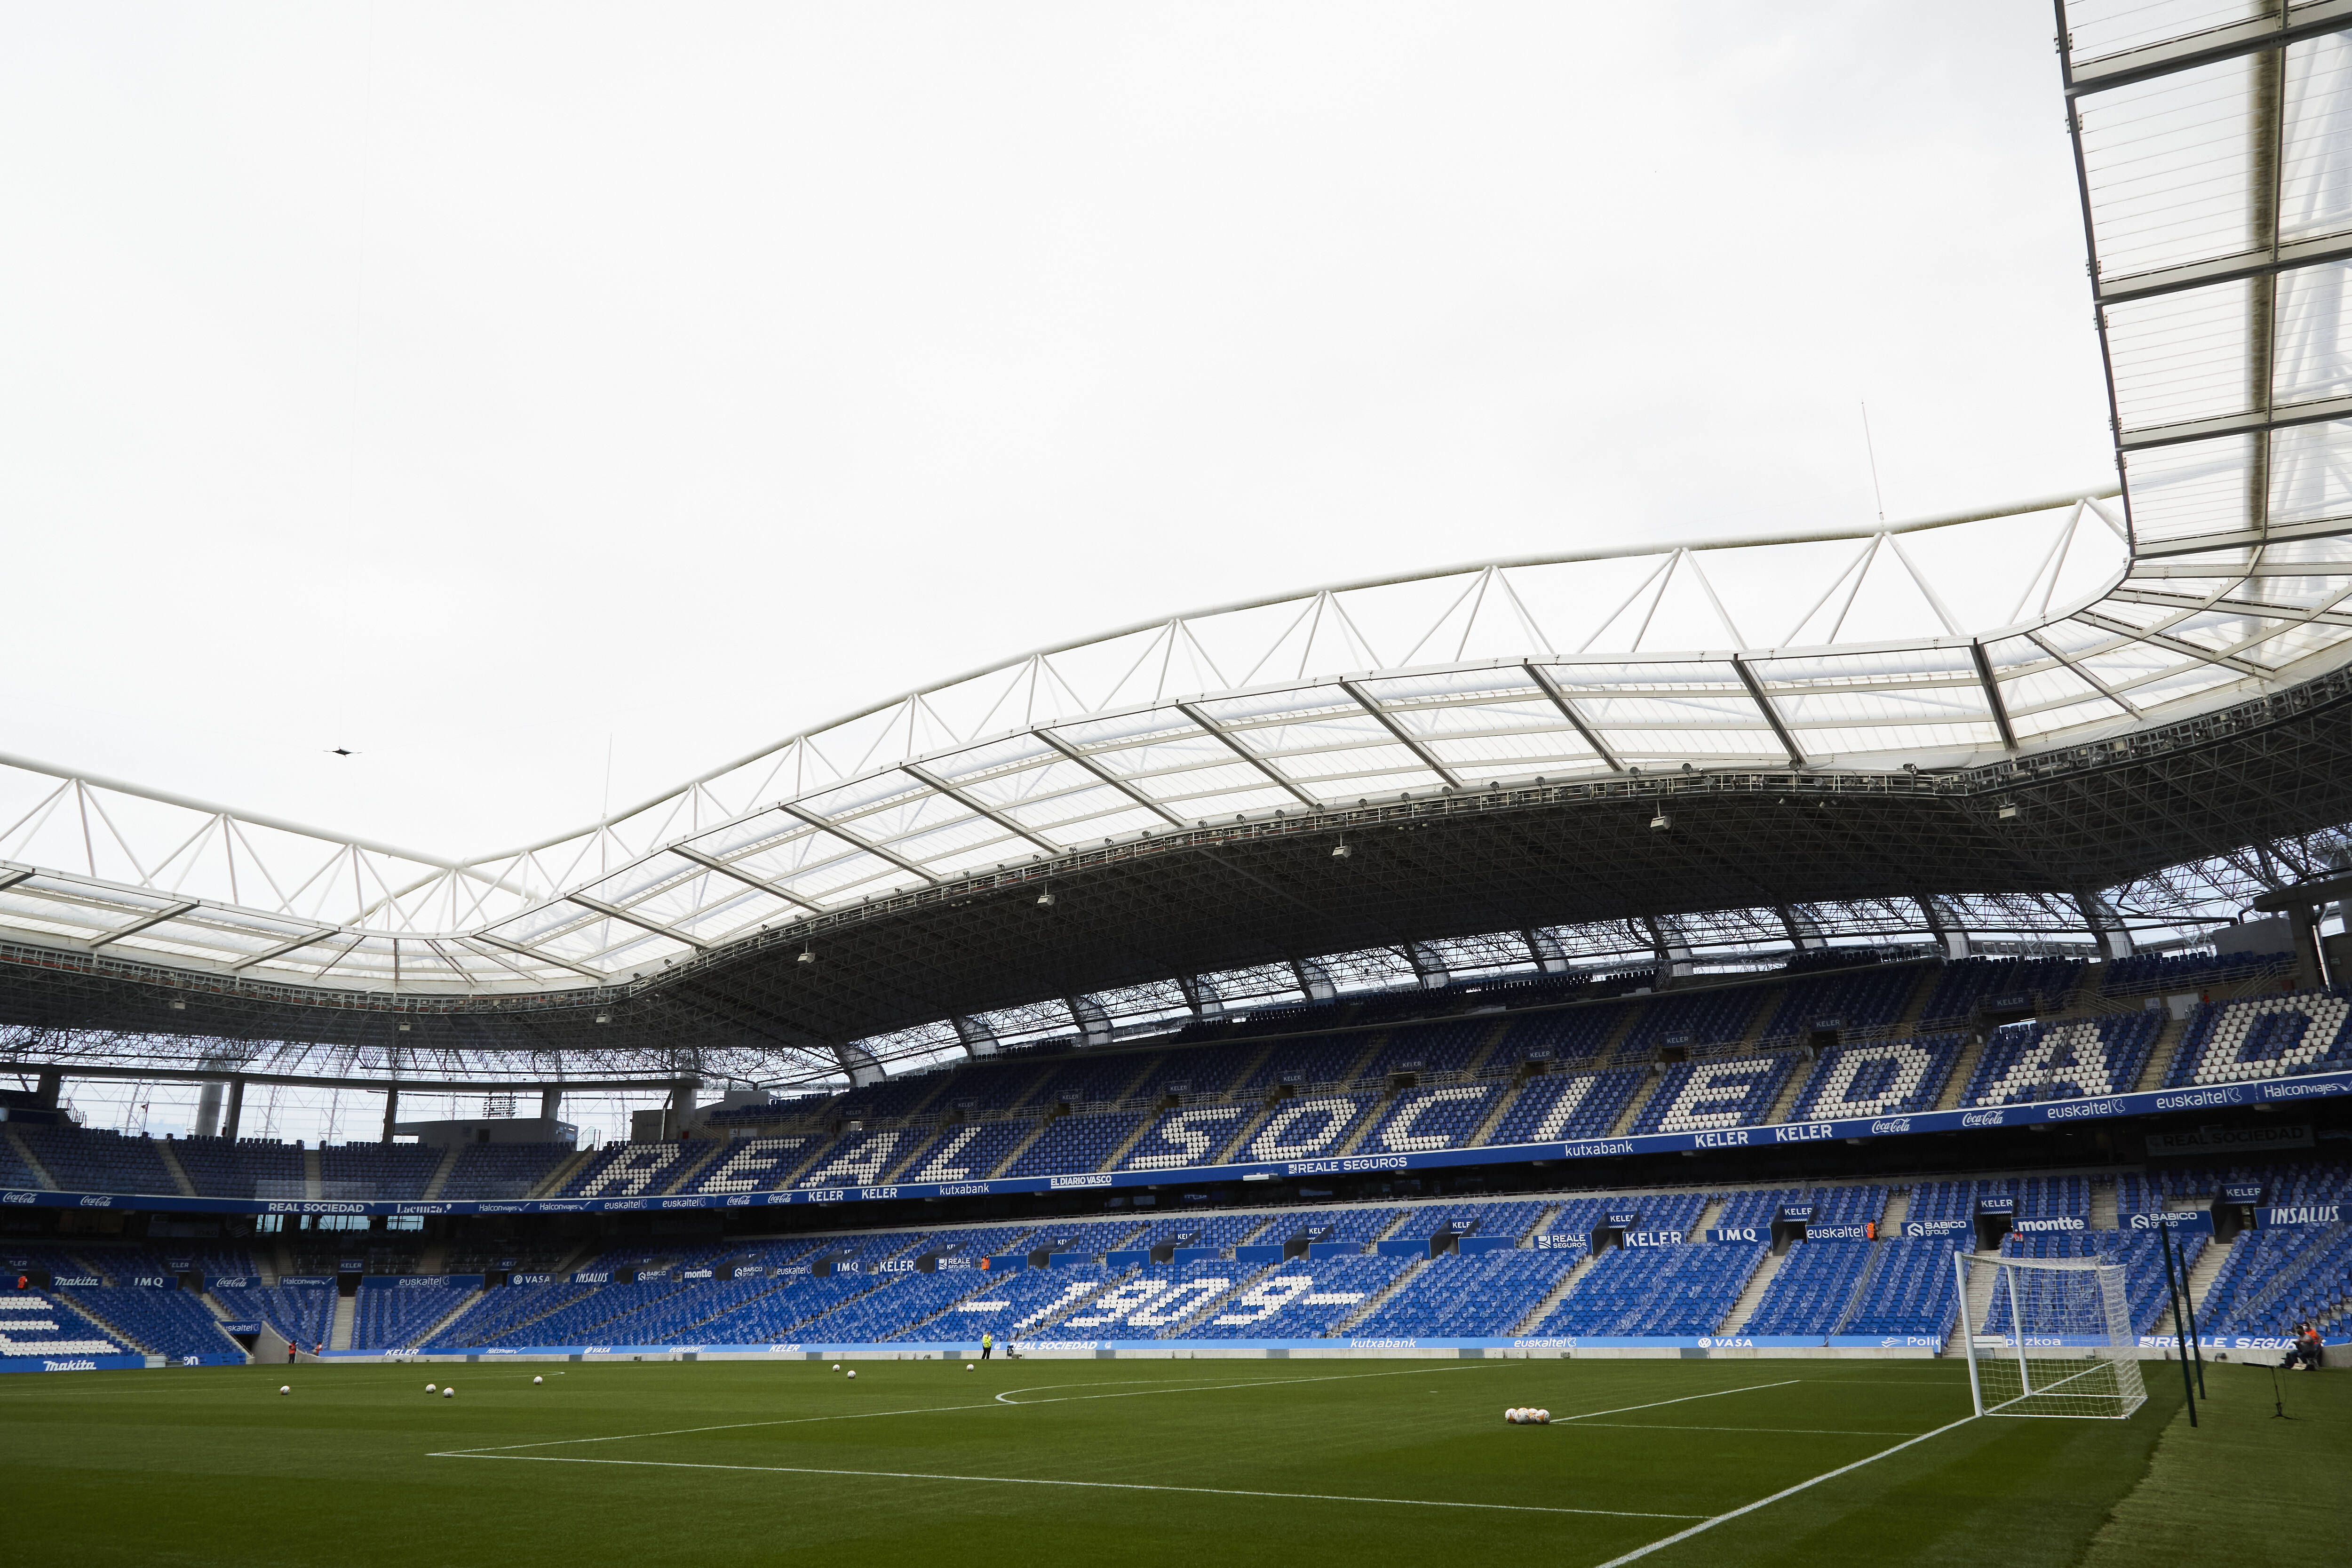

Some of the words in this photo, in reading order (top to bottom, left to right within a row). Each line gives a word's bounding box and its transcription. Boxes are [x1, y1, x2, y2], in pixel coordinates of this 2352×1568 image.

[1997, 998, 2024, 1006] KELER
[2157, 1089, 2227, 1109] euskaltel
[2048, 1100, 2112, 1119] euskaltel
[1776, 1124, 1833, 1142] KELER
[2163, 1133, 2209, 1147] REAL
[2212, 1128, 2304, 1144] SOCIEDAD
[1695, 1131, 1748, 1148] KELER
[1565, 1140, 1634, 1157] kutxabank
[1298, 1162, 1339, 1173] REALE
[1343, 1157, 1407, 1170] SEGUROS
[1050, 1178, 1059, 1186] EL
[1060, 1176, 1086, 1185] DIARIO
[1086, 1175, 1112, 1185] VASCO
[861, 1187, 897, 1199] KELER
[940, 1183, 989, 1195] kutxabank
[808, 1190, 843, 1202] KELER
[268, 1203, 300, 1212] REAL
[303, 1203, 365, 1213] SOCIEDAD
[604, 1201, 640, 1210] euskaltel
[662, 1198, 699, 1208] euskaltel
[1981, 1199, 2013, 1208] KELER
[2150, 1212, 2197, 1221] SABICO
[2270, 1206, 2339, 1224] INSALUS
[1924, 1220, 1966, 1229] SABICO
[2018, 1217, 2084, 1232] montte
[1718, 1228, 1758, 1242] IMQ
[1807, 1225, 1864, 1240] euskaltel
[1625, 1232, 1682, 1247] KELER
[777, 1265, 806, 1275] euskaltel
[837, 1262, 859, 1273] IMQ
[880, 1260, 914, 1272] KELER
[575, 1273, 608, 1283] INSALUS
[684, 1269, 712, 1279] montte
[134, 1277, 164, 1288] IMQ
[399, 1277, 442, 1286] euskaltel
[1009, 1342, 1036, 1350] REAL
[1038, 1341, 1098, 1350] SOCIEDAD
[1350, 1337, 1416, 1348] kutxabank
[1514, 1337, 1566, 1348] euskaltel
[1715, 1338, 1753, 1347] VASA
